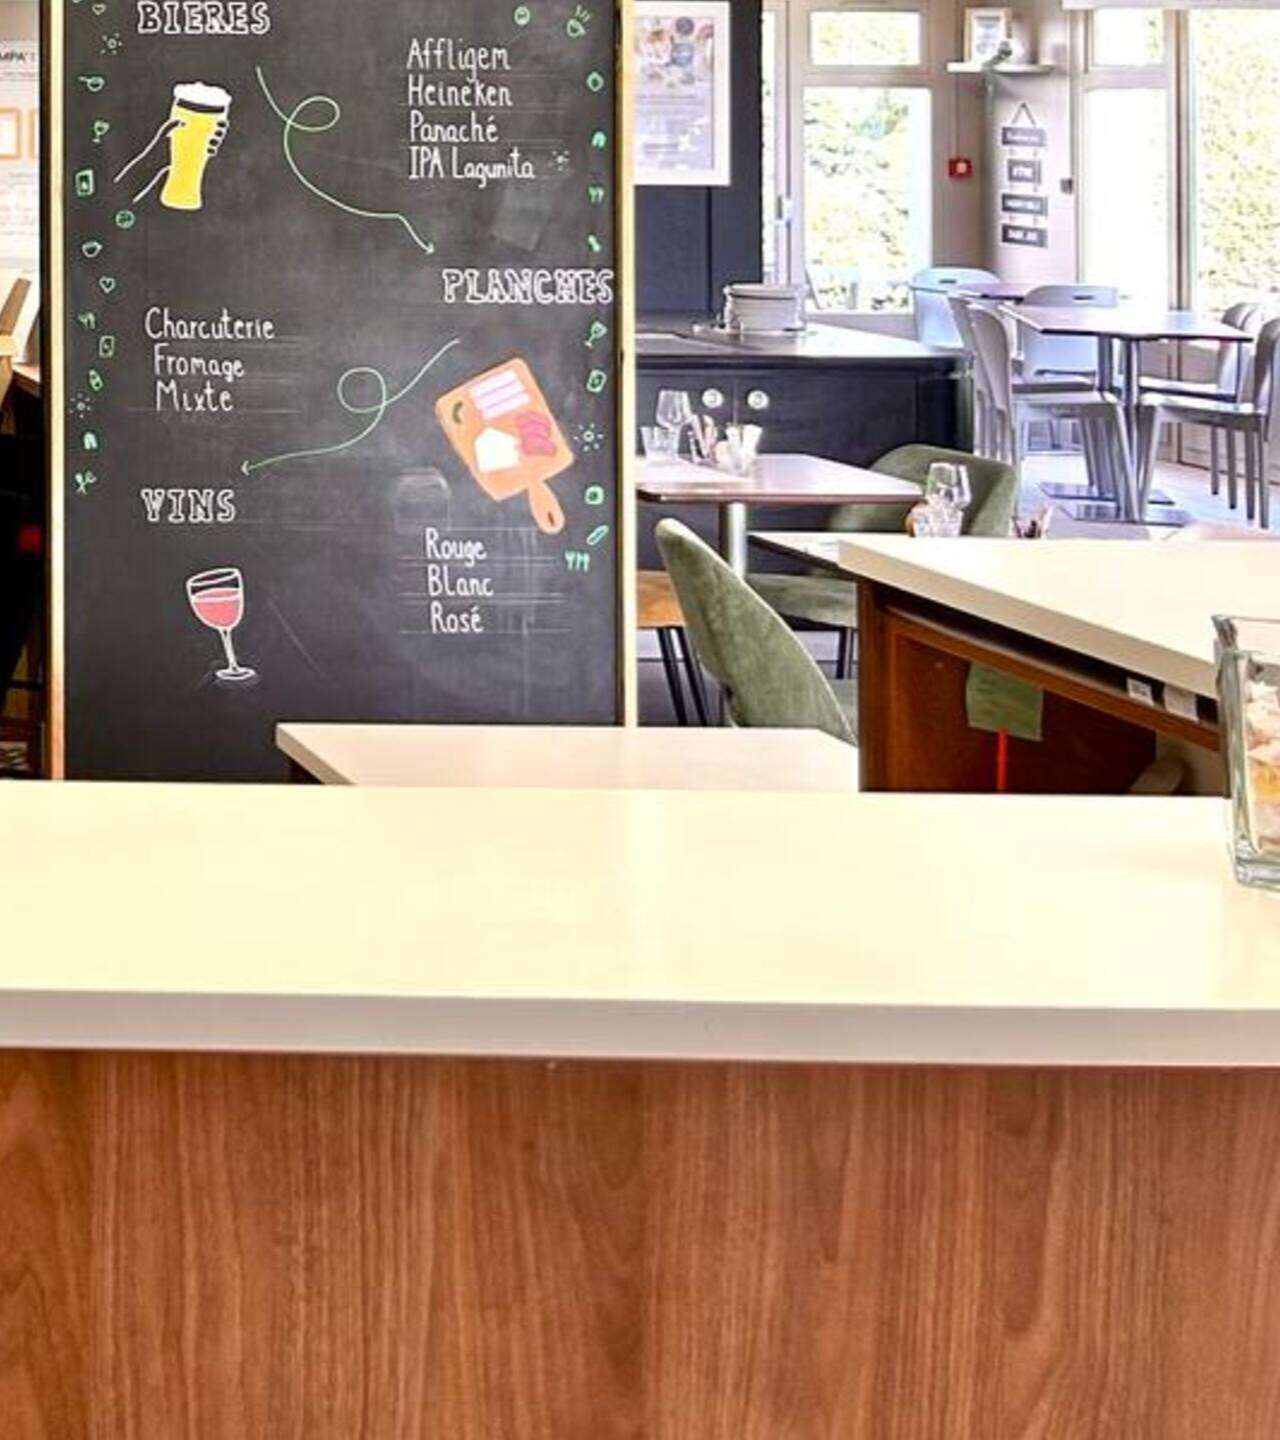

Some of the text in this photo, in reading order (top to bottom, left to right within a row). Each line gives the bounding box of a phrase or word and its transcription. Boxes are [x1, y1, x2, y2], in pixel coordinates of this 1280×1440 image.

[137, 0, 271, 35] BIERES
[406, 37, 512, 82] Affligem
[407, 73, 513, 107] Heineken
[410, 109, 499, 143] Panaché
[409, 146, 536, 189] IPA Lagunita
[441, 267, 615, 305] PLANCHES
[144, 306, 276, 340] Charcuterie
[153, 342, 246, 383] Fromage
[156, 378, 234, 412] Mixte
[140, 488, 236, 524] VINS
[425, 526, 488, 568] Rouge
[427, 563, 495, 597] Blanc
[430, 600, 485, 635] Rosé
